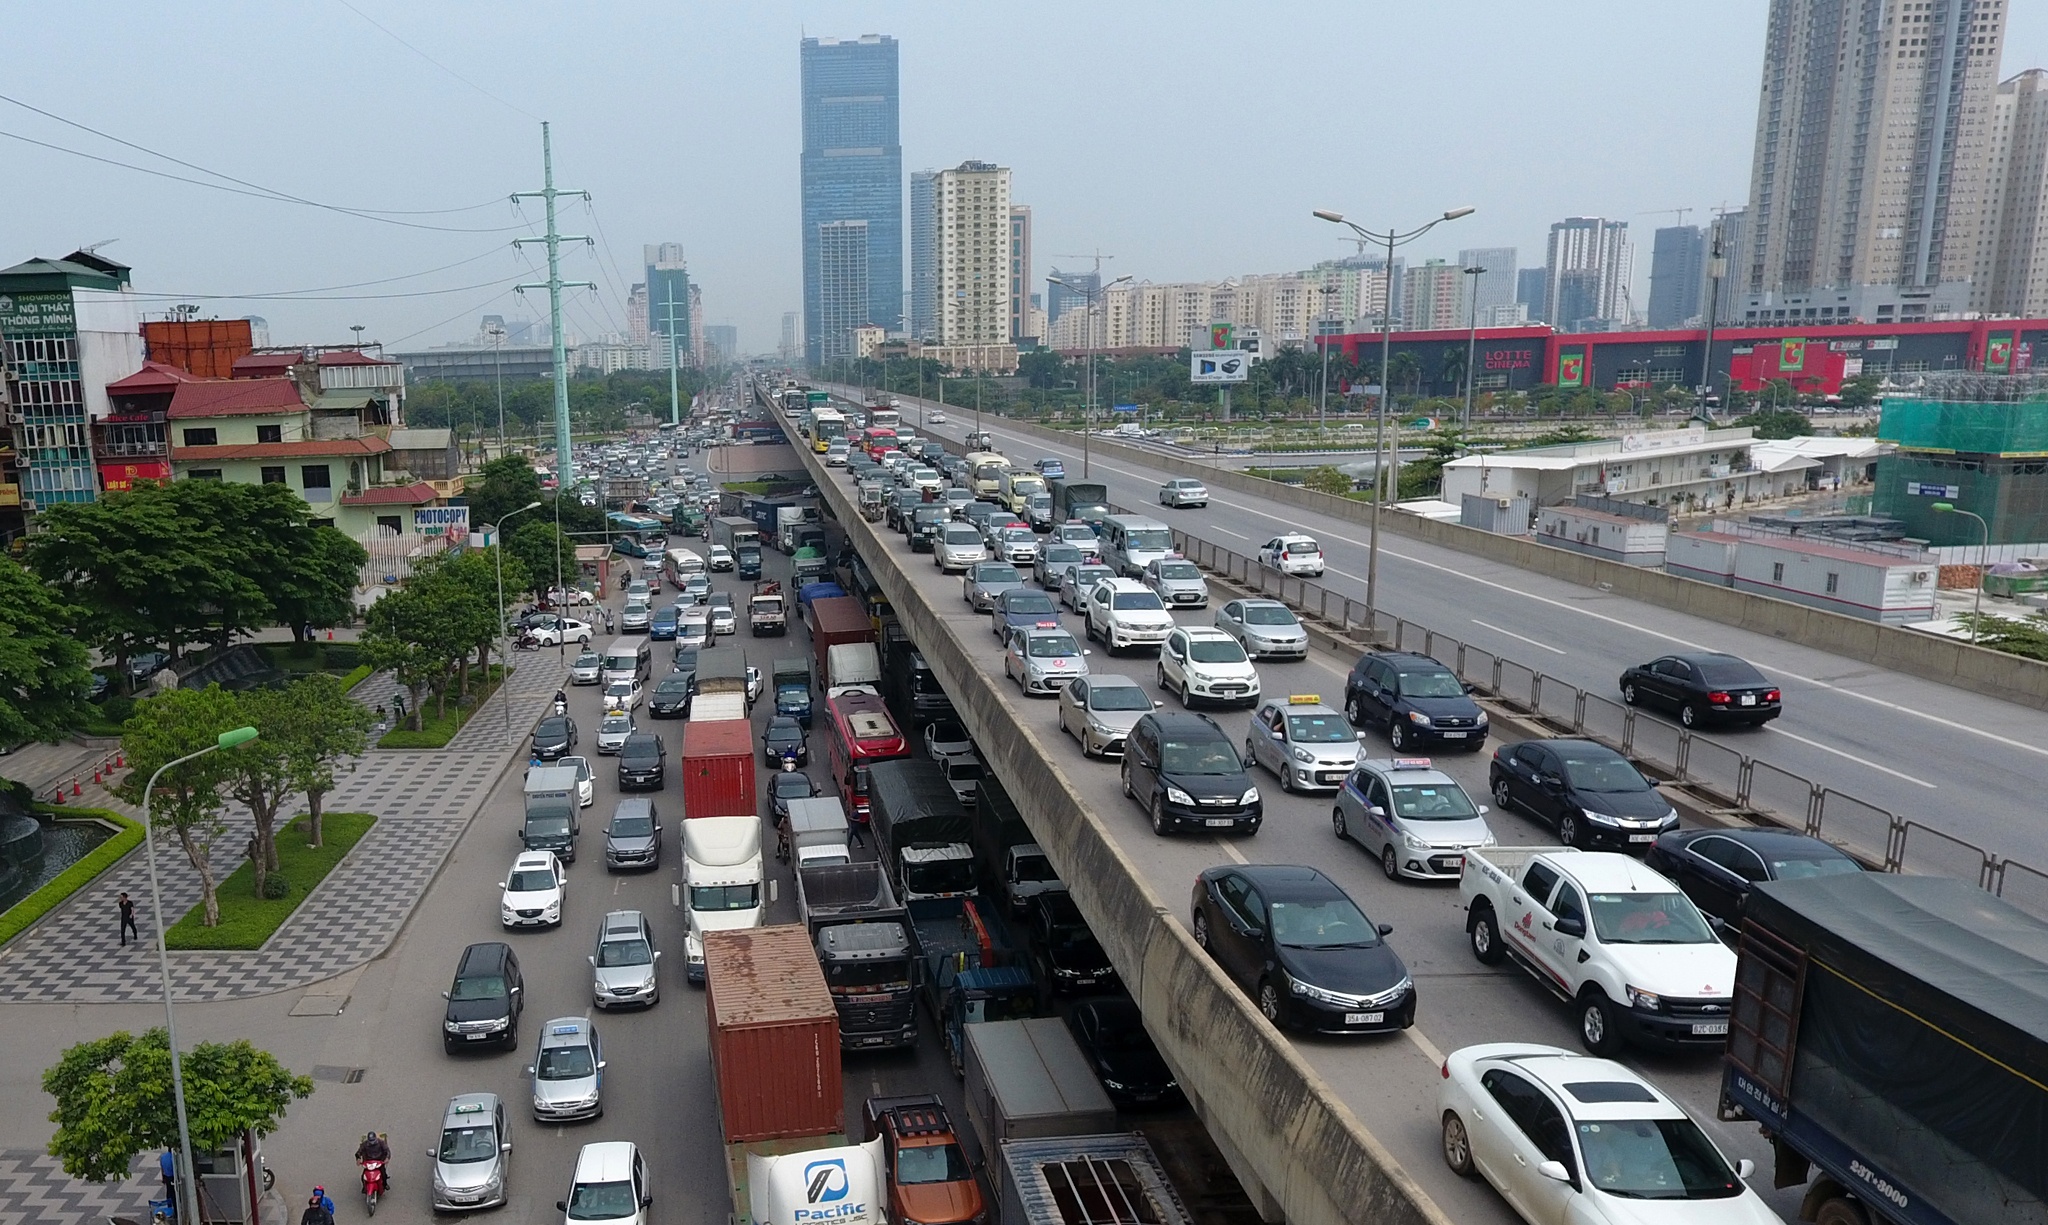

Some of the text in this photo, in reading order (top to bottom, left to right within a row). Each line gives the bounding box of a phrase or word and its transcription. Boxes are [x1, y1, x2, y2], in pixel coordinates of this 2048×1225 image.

[18, 294, 70, 302] SHOWROOM
[19, 303, 38, 314] NỘI
[1, 314, 40, 326] THÔNG
[1486, 351, 1532, 361] LOTTE
[1485, 360, 1531, 369] CINEMA
[414, 508, 467, 524] PHOTOCOPY
[794, 1202, 866, 1222] Pacific
